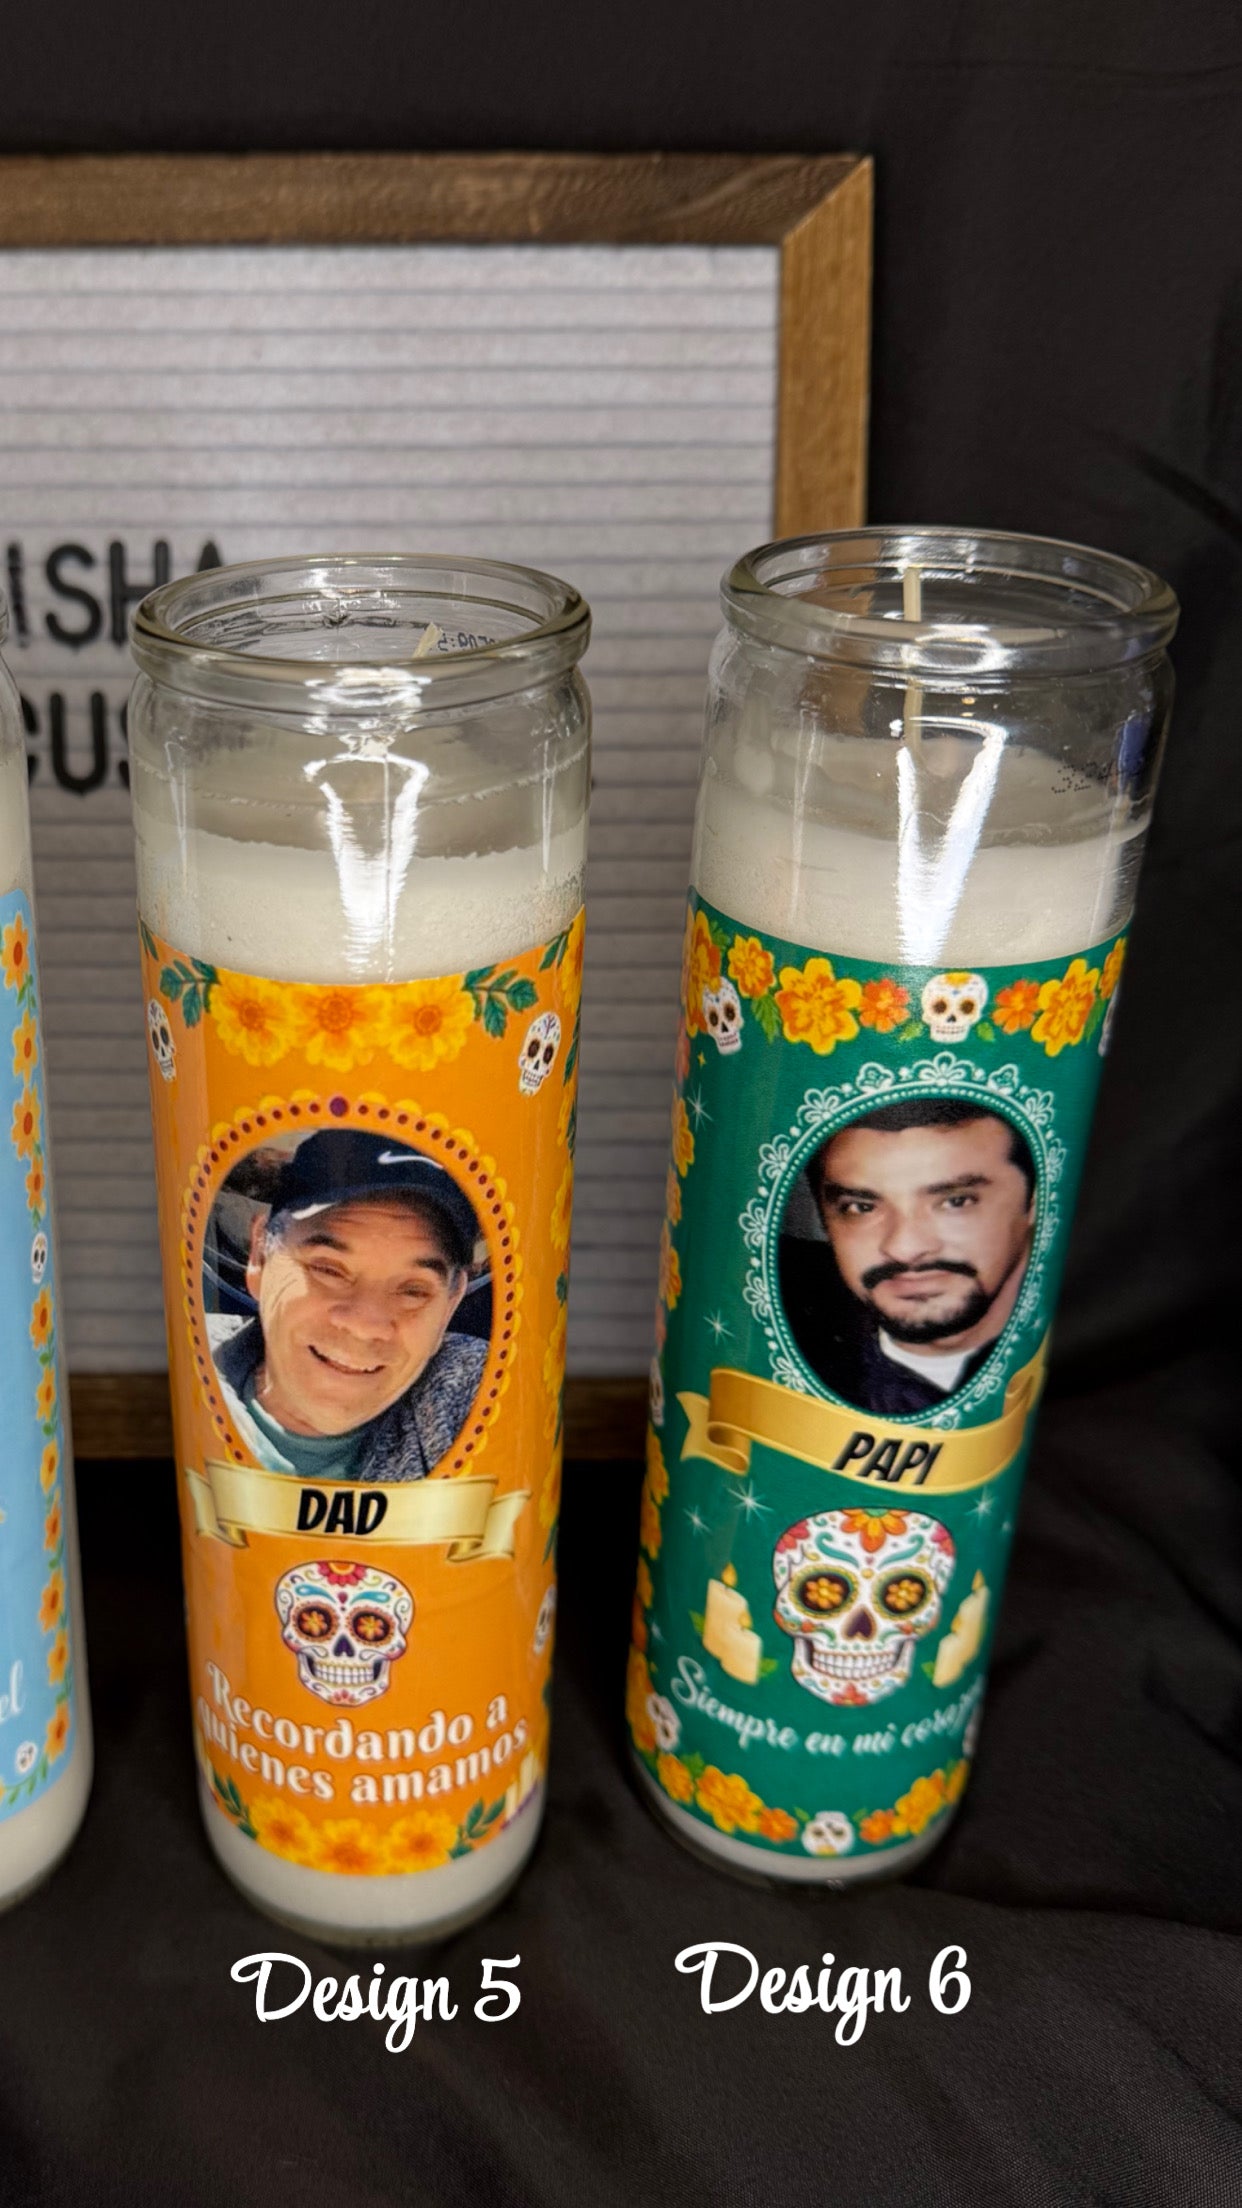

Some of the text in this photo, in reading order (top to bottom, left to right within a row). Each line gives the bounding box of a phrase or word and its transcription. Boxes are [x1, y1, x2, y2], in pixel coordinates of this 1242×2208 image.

[832, 1431, 944, 1485] PAPI
[296, 1488, 387, 1535] DAD
[206, 1662, 507, 1761] Recordando a
[671, 1655, 798, 1751] Siempre
[804, 1732, 845, 1756] en
[852, 1722, 897, 1755] mi
[350, 1719, 528, 1804] amamos
